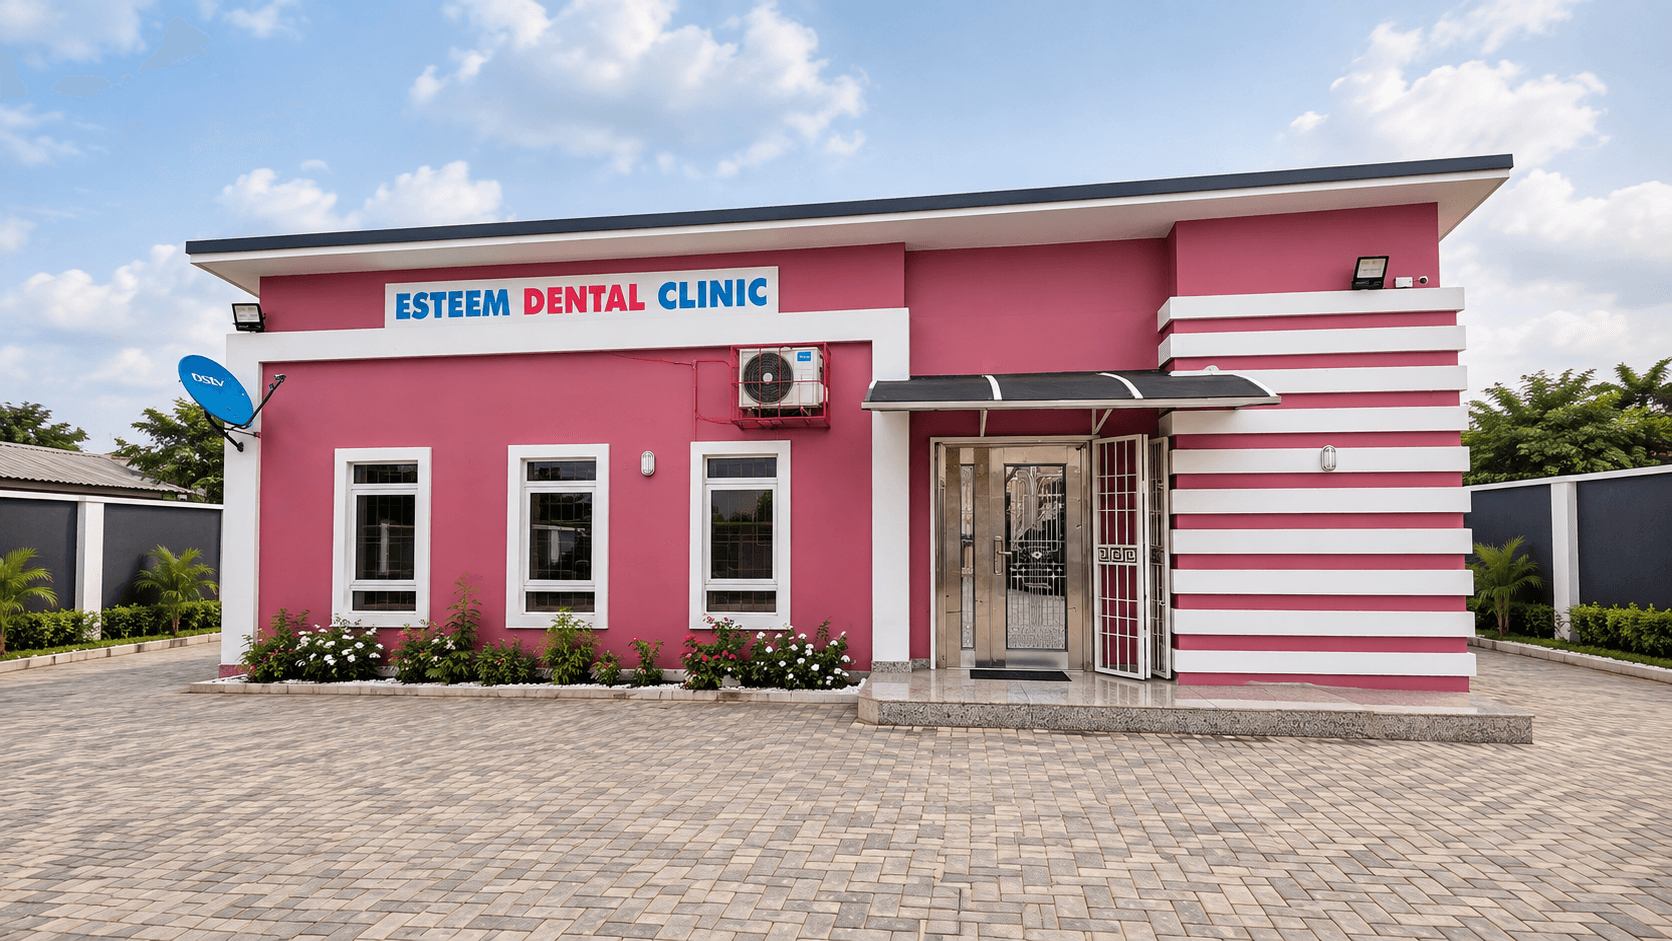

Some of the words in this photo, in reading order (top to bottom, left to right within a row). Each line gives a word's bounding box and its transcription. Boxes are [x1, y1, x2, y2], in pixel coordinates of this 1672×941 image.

[395, 289, 510, 320] ESTEEM
[523, 283, 645, 315] DENTAL
[657, 278, 767, 311] CLINIC
